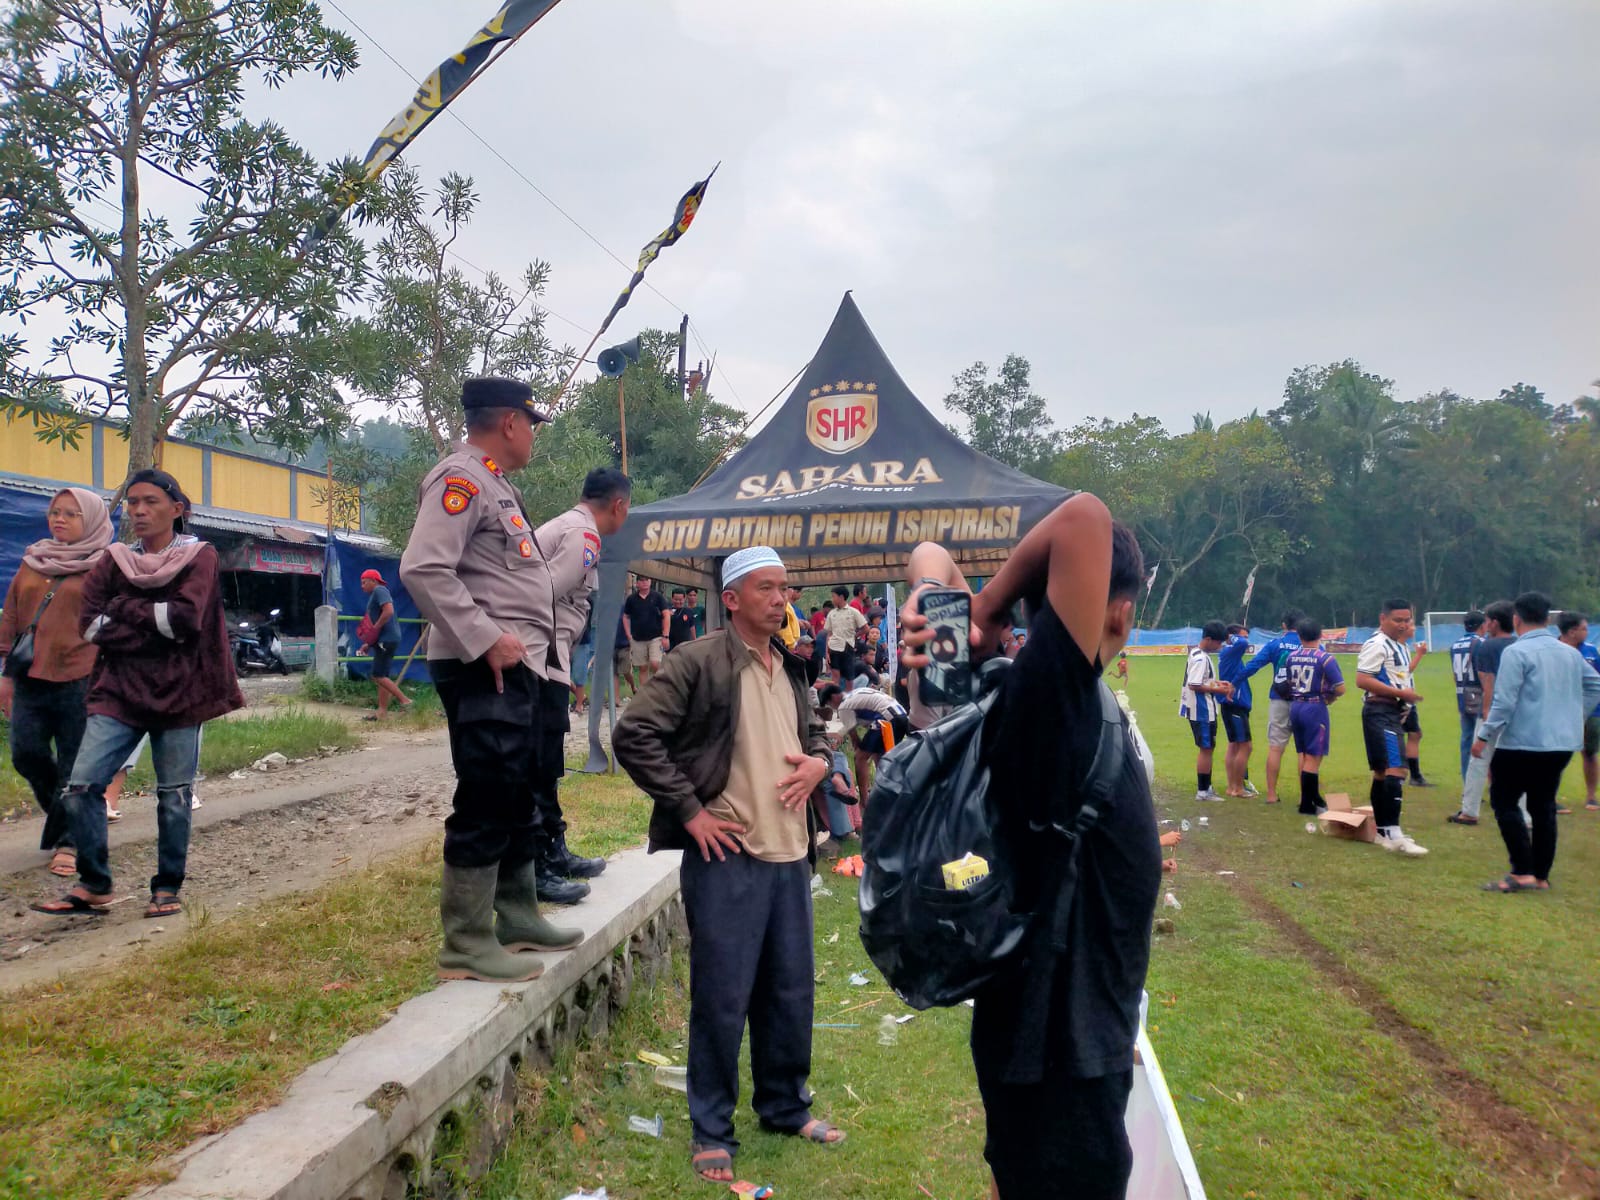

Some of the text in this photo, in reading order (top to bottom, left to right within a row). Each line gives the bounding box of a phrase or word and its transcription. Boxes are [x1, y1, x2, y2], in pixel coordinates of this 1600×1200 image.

[816, 405, 867, 441] SHR
[735, 457, 944, 500] SAHARA
[642, 506, 1022, 552] SATU BATANG PENUH ISNPIRASI
[1290, 664, 1315, 693] 99
[1453, 652, 1475, 681] 44
